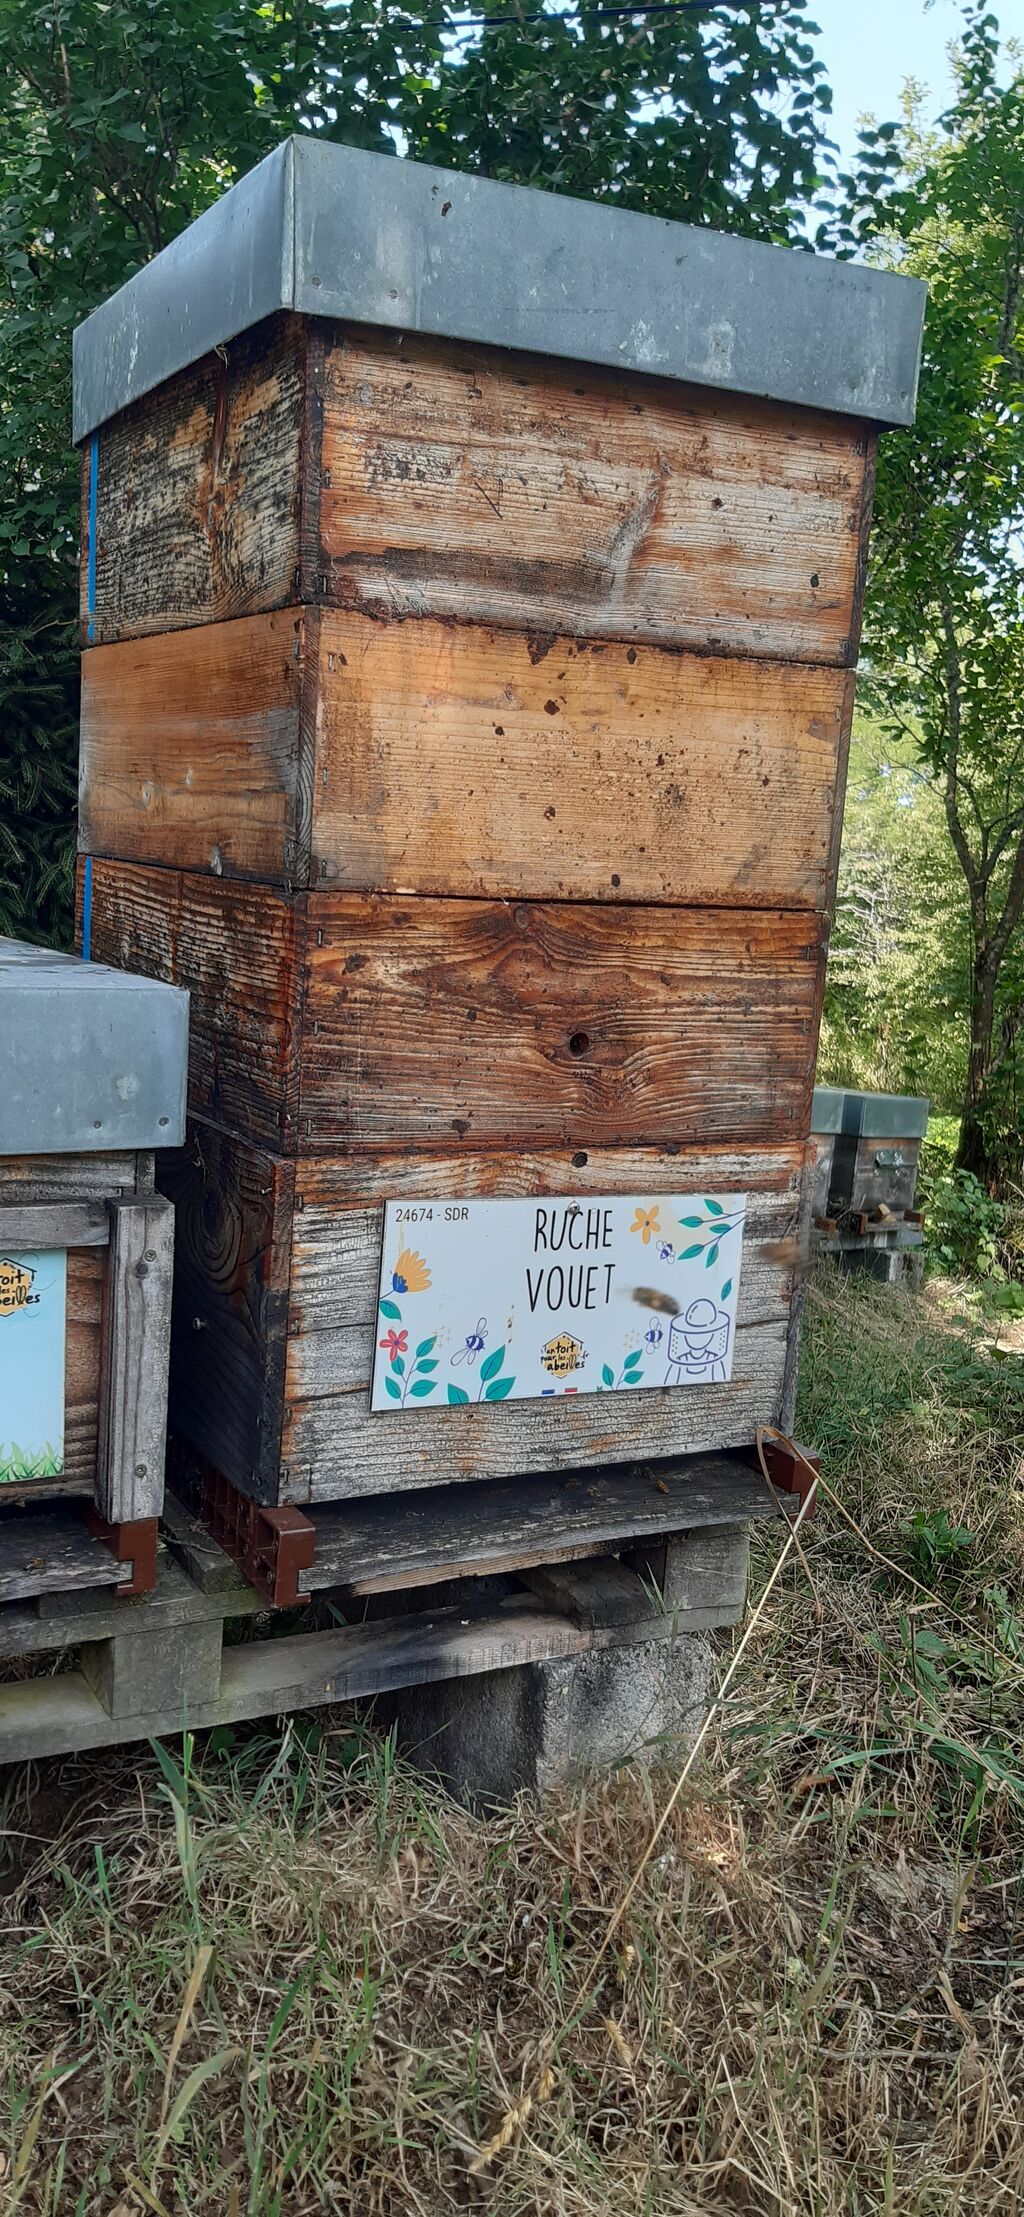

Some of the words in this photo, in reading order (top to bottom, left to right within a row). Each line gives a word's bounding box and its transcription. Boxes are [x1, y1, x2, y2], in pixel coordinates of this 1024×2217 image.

[395, 1208, 433, 1222] 24674
[444, 1207, 469, 1221] SDR
[534, 1208, 613, 1252] RUCHE
[526, 1264, 616, 1312] VOUET
[555, 1341, 576, 1354] toit
[547, 1354, 586, 1371] abeilles
